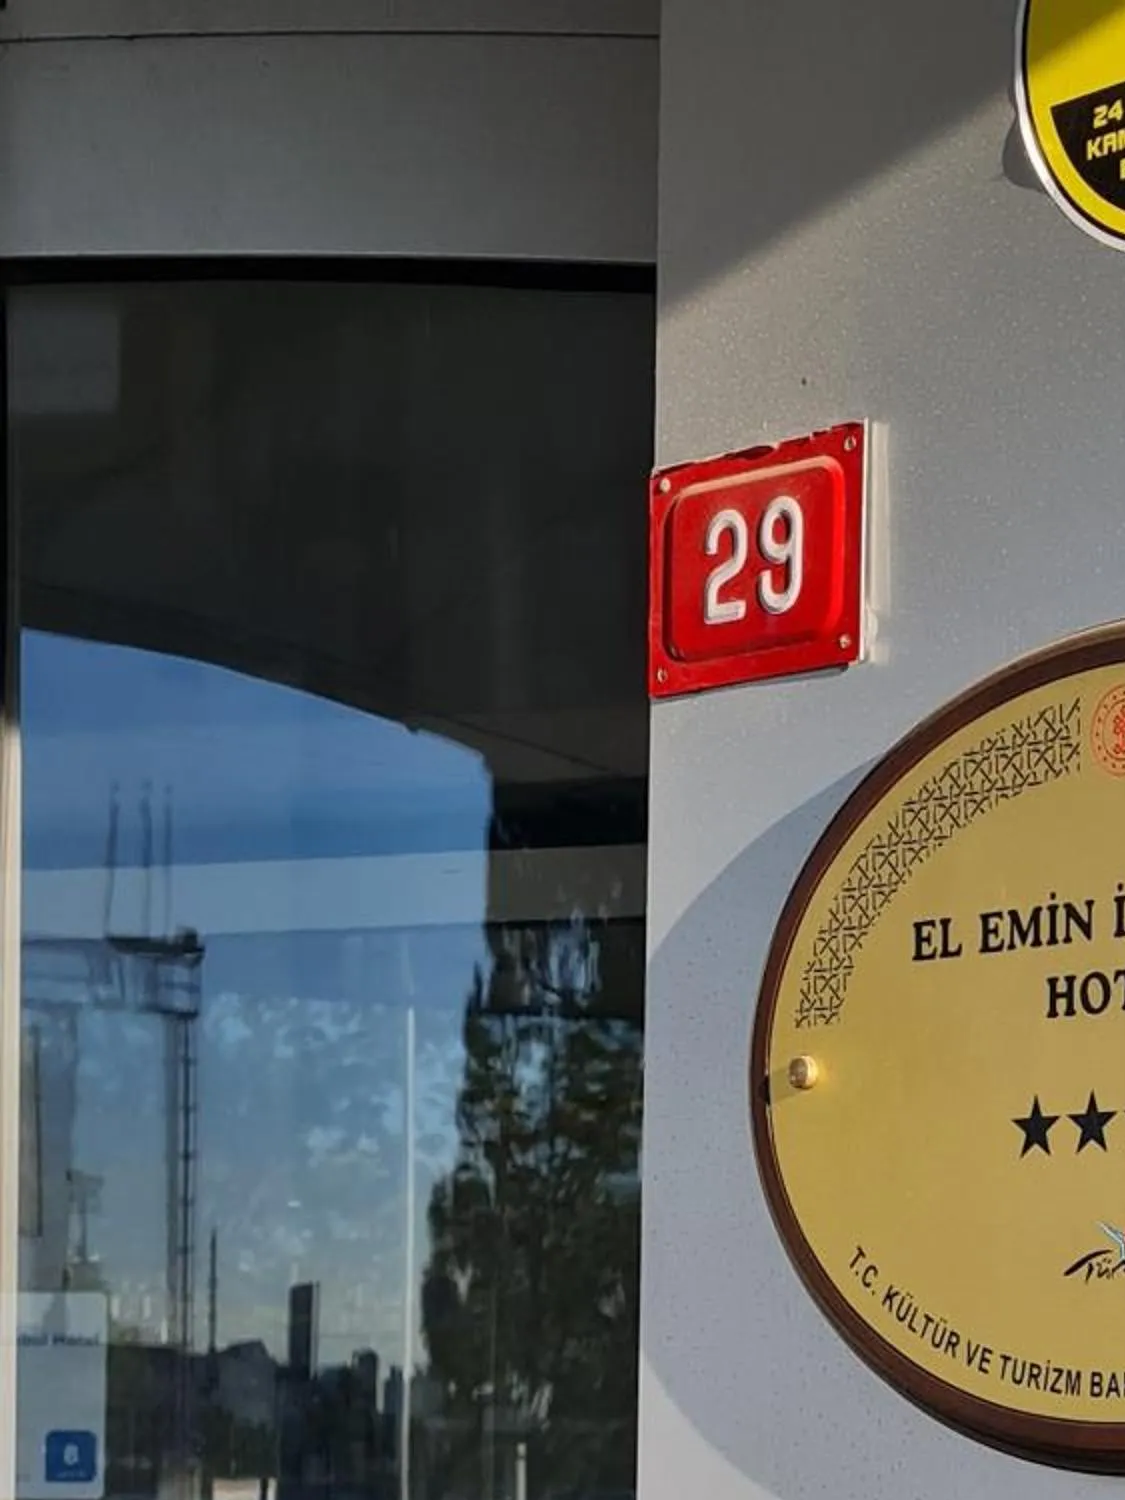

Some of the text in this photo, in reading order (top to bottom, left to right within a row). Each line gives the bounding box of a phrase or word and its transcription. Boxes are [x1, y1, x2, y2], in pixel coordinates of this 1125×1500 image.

[1093, 98, 1123, 129] 24
[704, 495, 804, 625] 29
[911, 917, 963, 961] EL
[978, 891, 1095, 953] EMİN
[848, 1246, 878, 1296] T.C.
[882, 1284, 961, 1358] KÜLTÜR
[966, 1339, 993, 1375] VE
[1000, 1354, 1082, 1397] TURİZM
